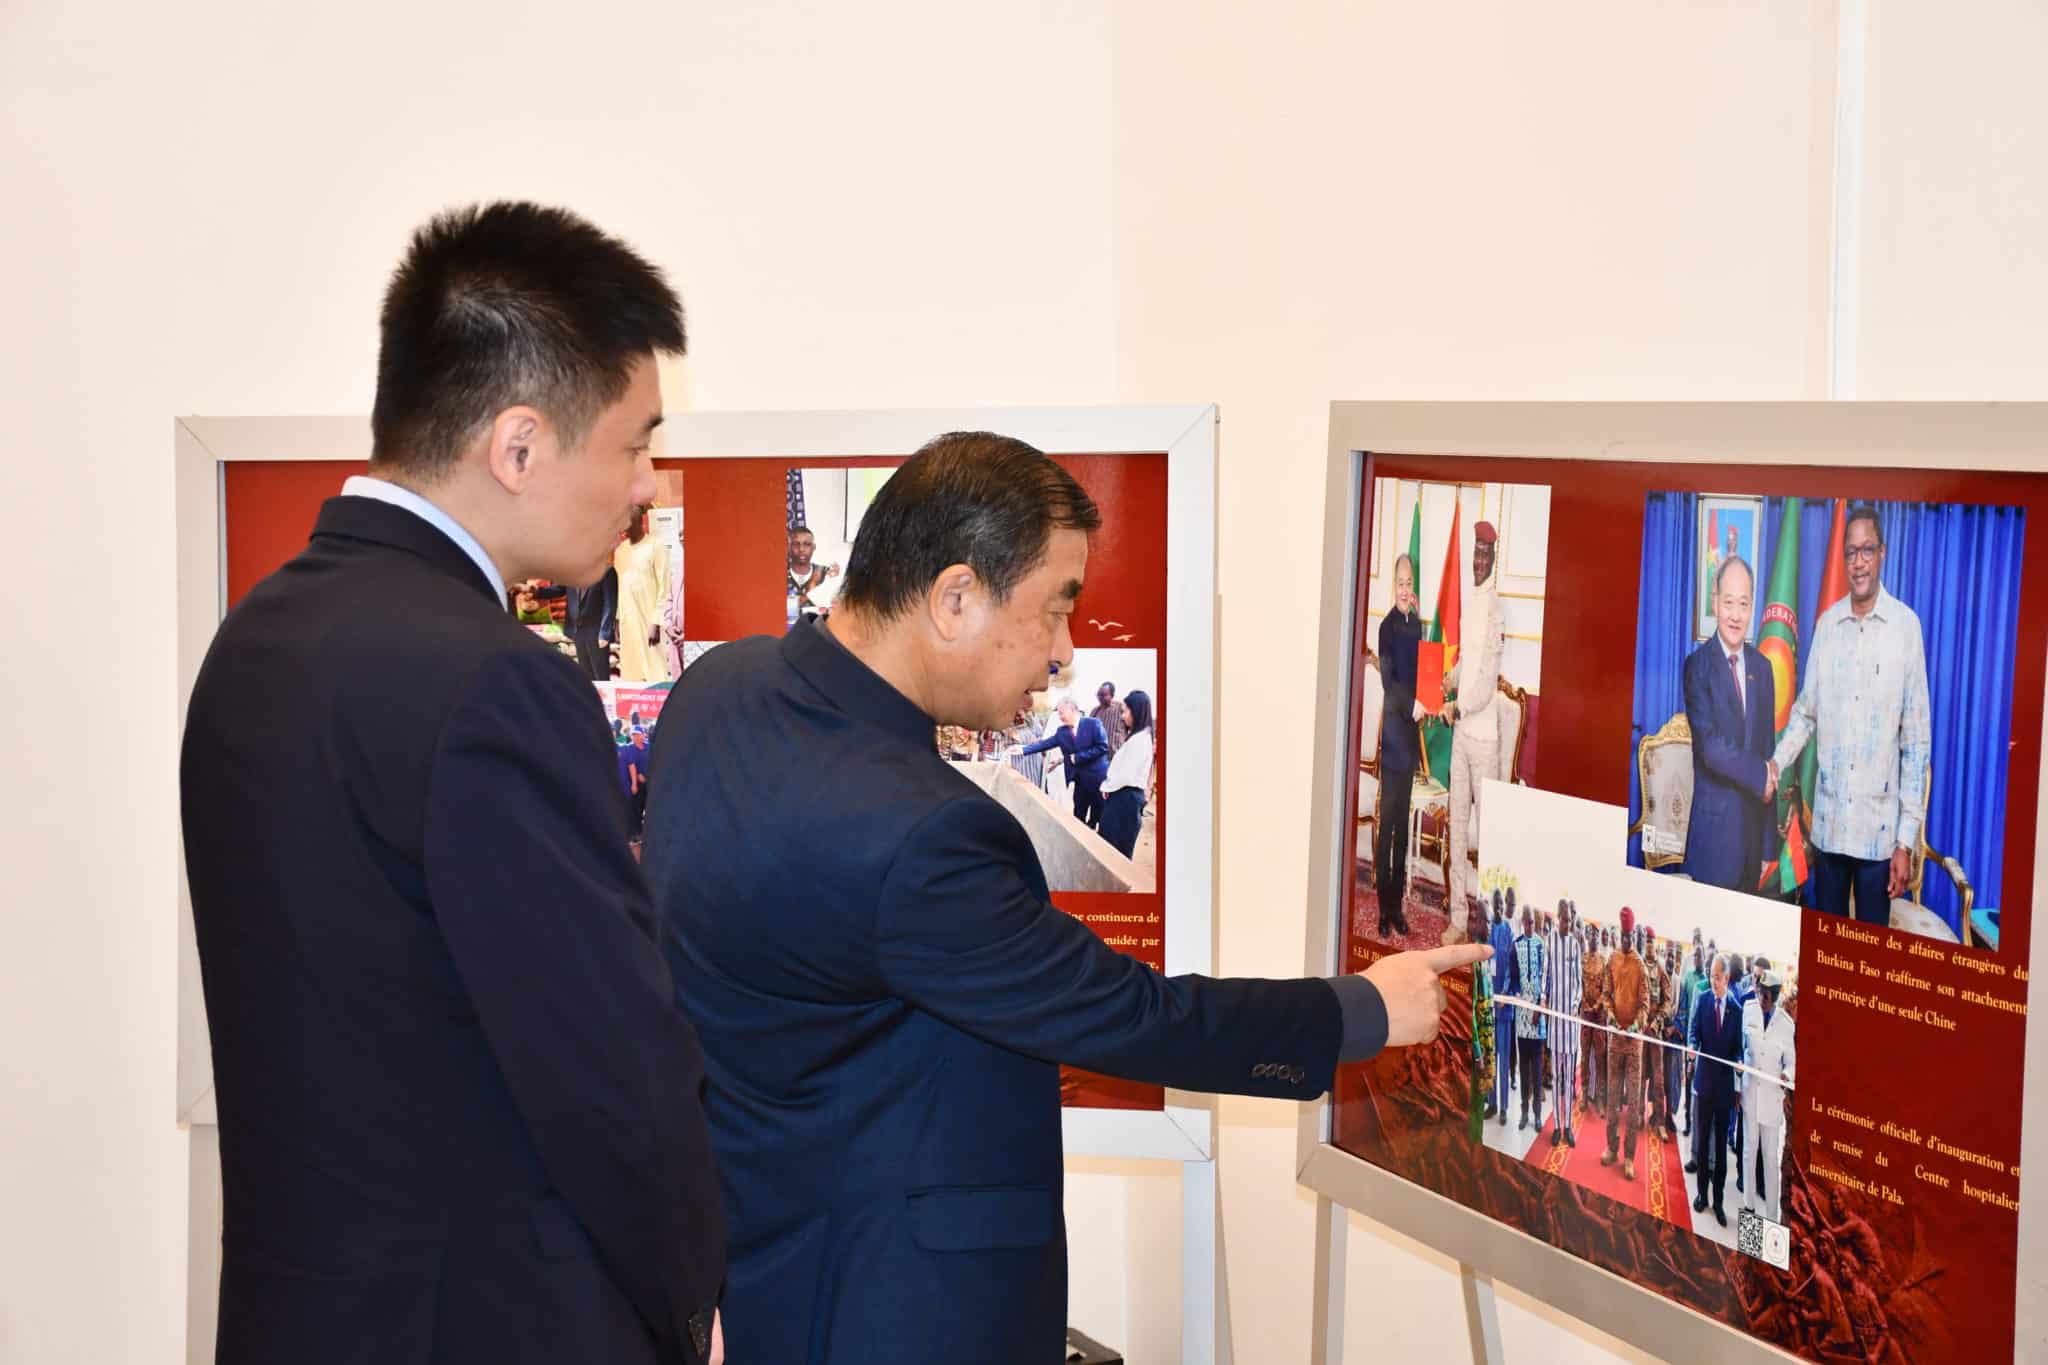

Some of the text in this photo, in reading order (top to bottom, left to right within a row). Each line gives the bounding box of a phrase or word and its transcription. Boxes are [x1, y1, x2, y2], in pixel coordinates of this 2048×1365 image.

[1086, 911, 1143, 922] continuera
[1146, 911, 1160, 923] de
[1141, 937, 1160, 948] par
[1817, 918, 2029, 981] Le Ministère des affaires étrangères du
[1815, 983, 1957, 1031] au principe d'une seule Chine
[1816, 949, 2028, 1016] Burkina Faso réaffirme son attachement
[1811, 1096, 1823, 1113] La
[1827, 1104, 1875, 1130] cérémonie
[1880, 1121, 1922, 1145] officielle
[1927, 1135, 2004, 1172] d'inauguration
[1809, 1162, 1905, 1206] universitaire de Pala.
[1810, 1130, 2020, 1212] de remise du Centre hospitalier
